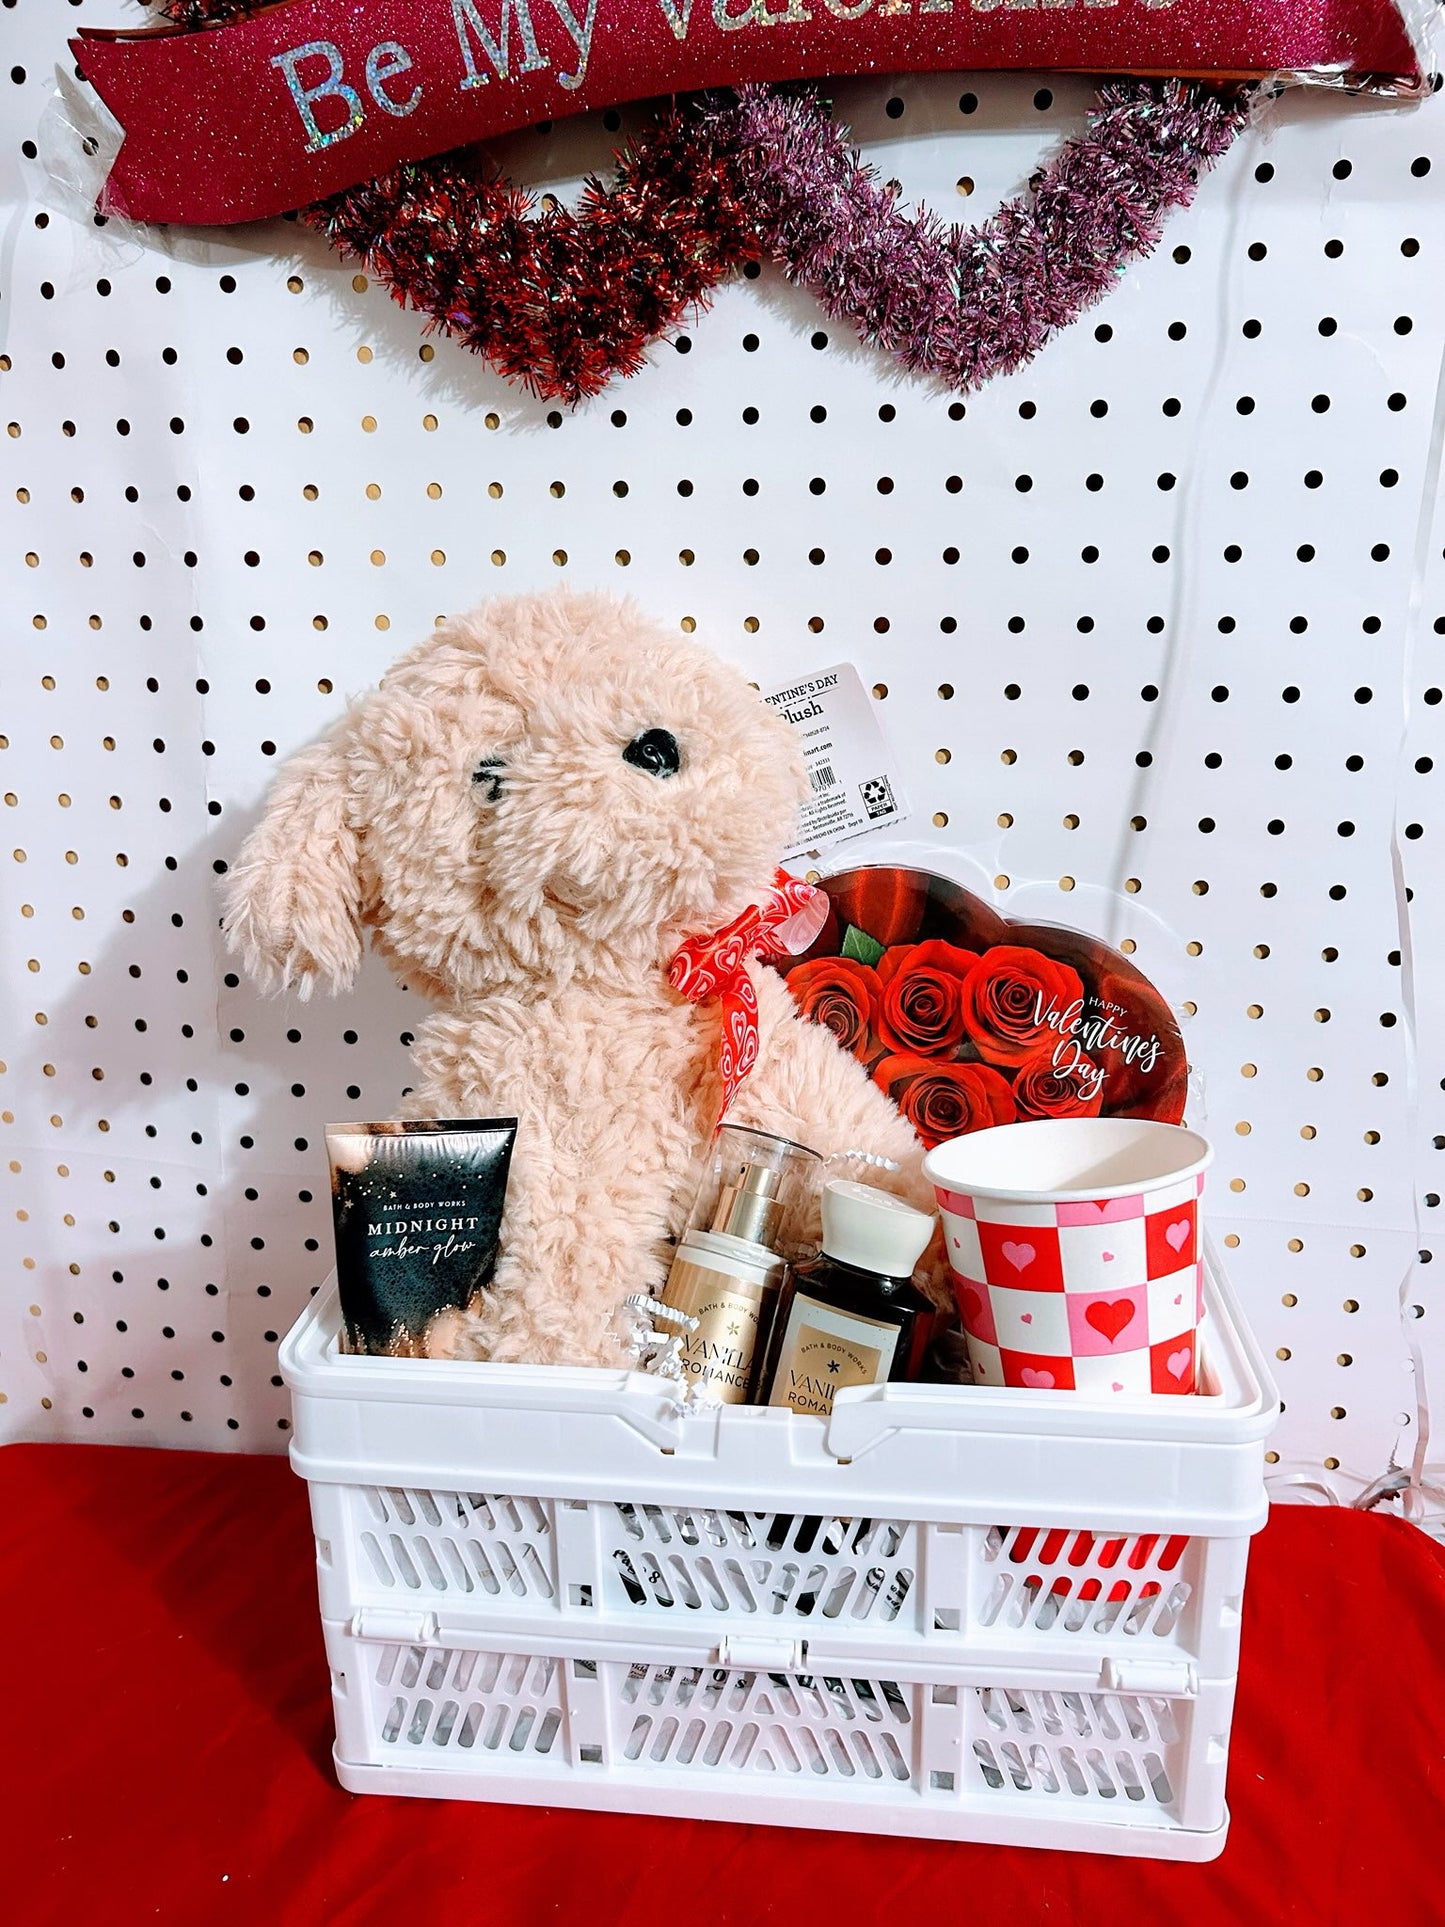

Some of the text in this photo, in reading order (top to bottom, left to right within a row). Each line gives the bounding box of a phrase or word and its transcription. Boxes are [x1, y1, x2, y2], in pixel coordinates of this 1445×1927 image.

[270, 0, 597, 153] Be My
[764, 674, 838, 705] ENTINE'S DAY
[803, 742, 833, 756] mart.com
[1088, 996, 1128, 1017] HAPPY
[1033, 989, 1166, 1073] Valentine's
[1052, 1039, 1111, 1101] Day
[383, 1203, 403, 1212] BATH
[413, 1201, 435, 1209] BODY
[438, 1200, 467, 1208] WORKS
[367, 1217, 480, 1236] MIDNIGHT
[369, 1234, 477, 1265] amber glow
[698, 1302, 718, 1315] BATH
[728, 1303, 748, 1313] BODY
[801, 1343, 818, 1354] BATH
[827, 1342, 846, 1353] BODY
[847, 1352, 868, 1375] WORKS
[791, 1369, 835, 1400] VANIL
[788, 1391, 833, 1416] ROMA
